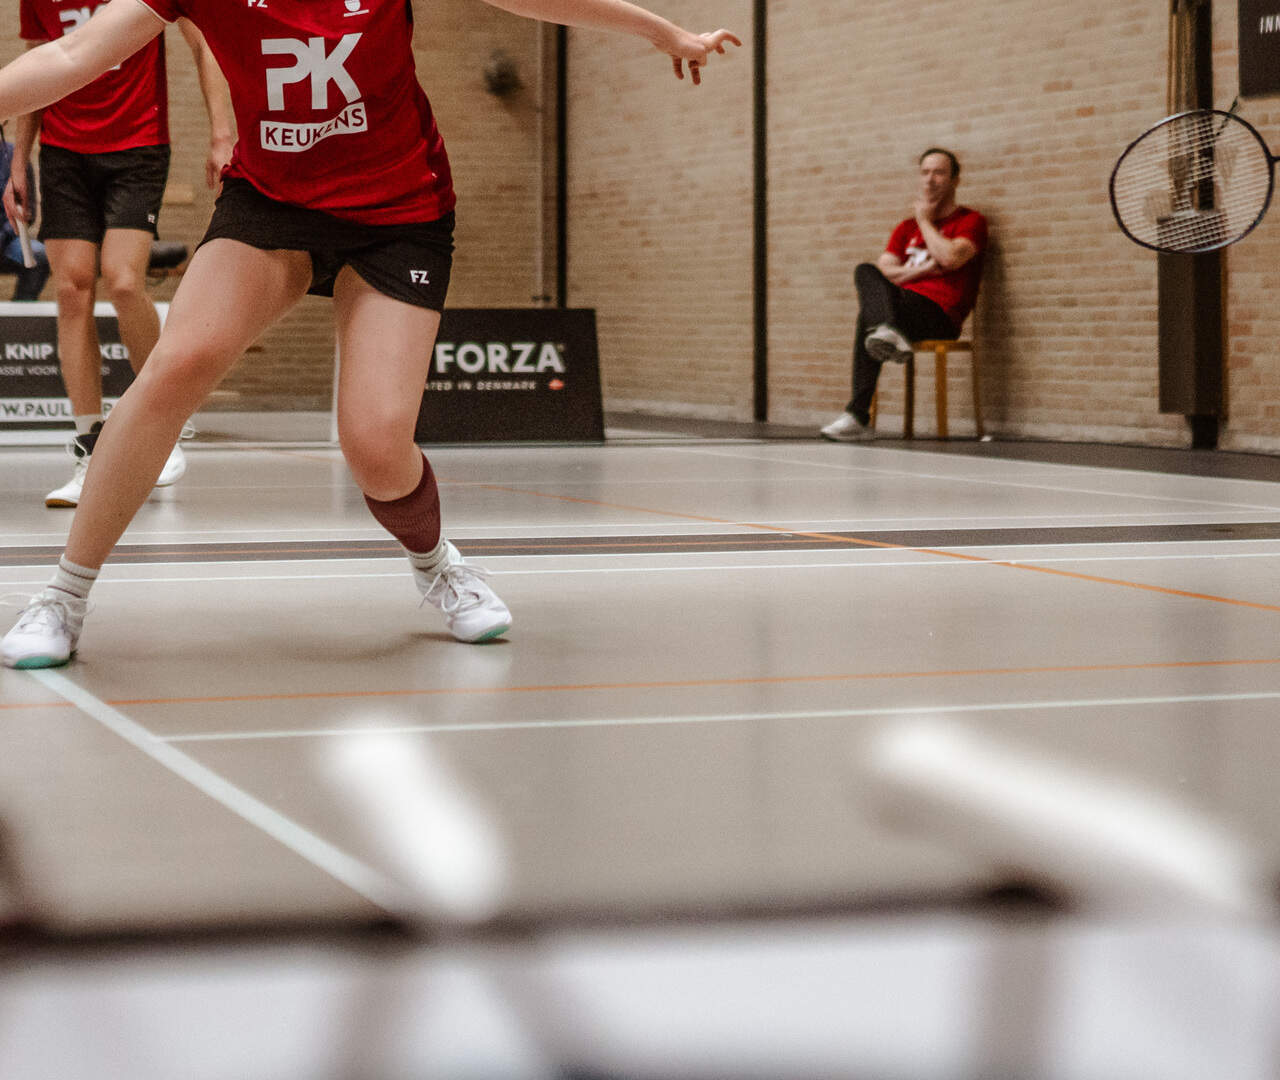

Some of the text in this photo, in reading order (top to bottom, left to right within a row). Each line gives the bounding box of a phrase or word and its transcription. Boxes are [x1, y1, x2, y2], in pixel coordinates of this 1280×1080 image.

[261, 32, 363, 111] PK
[265, 108, 365, 147] KEUKENS
[410, 270, 430, 285] FZ
[6, 343, 54, 361] KNIP
[476, 380, 537, 391] DENMARK
